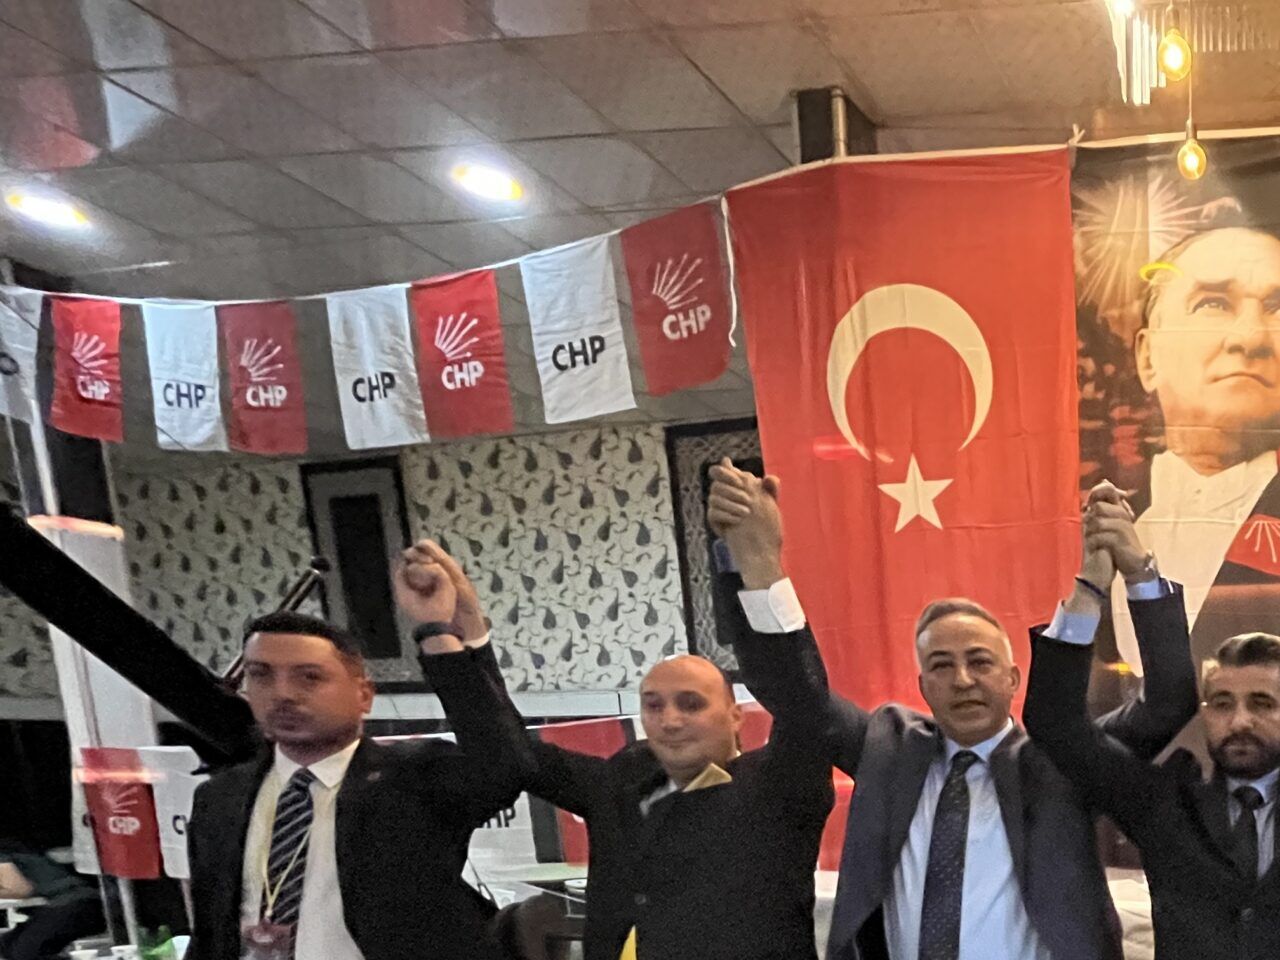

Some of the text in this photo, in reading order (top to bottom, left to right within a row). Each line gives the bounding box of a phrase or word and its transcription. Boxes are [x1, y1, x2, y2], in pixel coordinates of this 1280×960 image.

[662, 304, 711, 340] CHP
[552, 335, 605, 371] CHP
[352, 371, 396, 403] CHP
[441, 361, 484, 390] CHP
[163, 382, 206, 408] CHP
[246, 384, 288, 408] CHP
